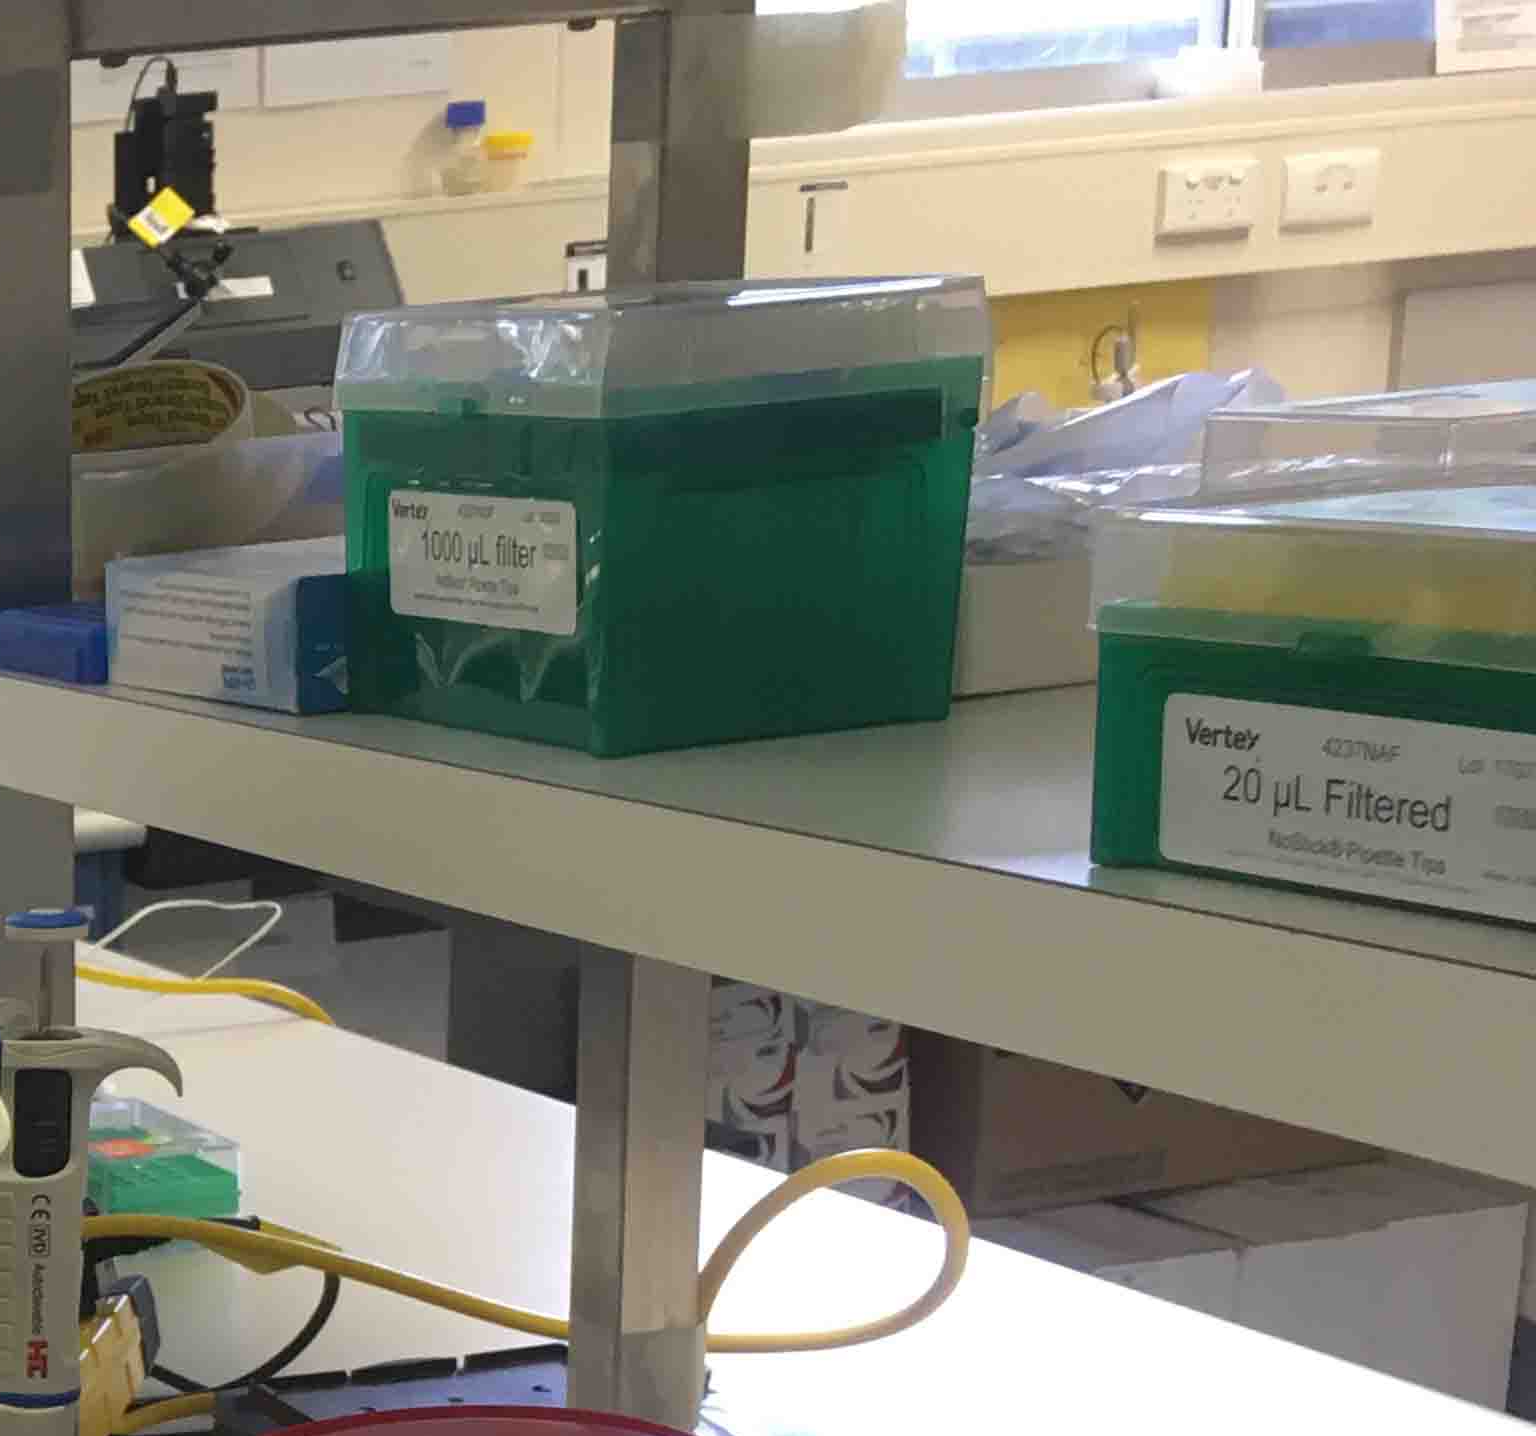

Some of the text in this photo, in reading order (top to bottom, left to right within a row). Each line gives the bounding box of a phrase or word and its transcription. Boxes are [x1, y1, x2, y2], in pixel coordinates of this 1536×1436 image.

[421, 529, 463, 563] 1000
[495, 534, 537, 570] filter
[1222, 764, 1262, 805] 20
[1272, 775, 1312, 818] µL
[1323, 777, 1453, 833] Filtered
